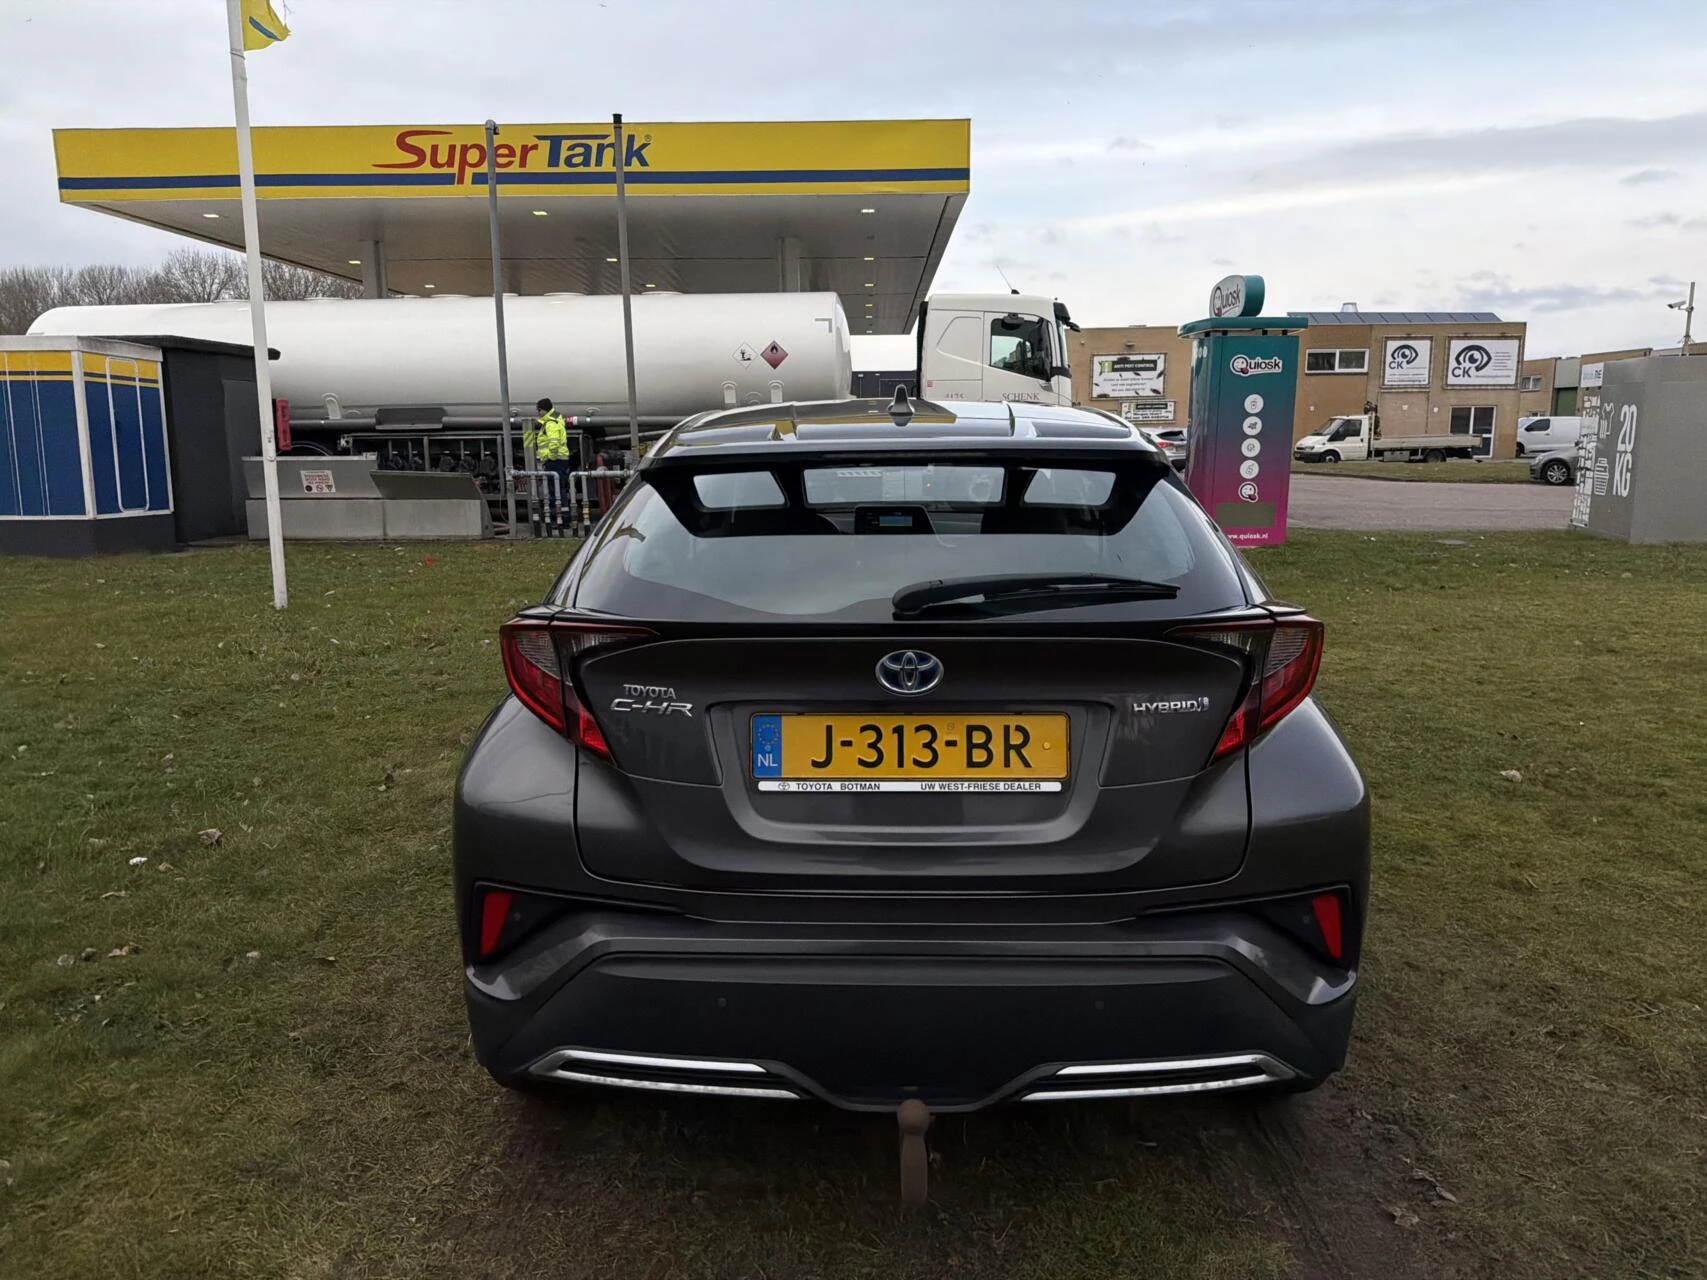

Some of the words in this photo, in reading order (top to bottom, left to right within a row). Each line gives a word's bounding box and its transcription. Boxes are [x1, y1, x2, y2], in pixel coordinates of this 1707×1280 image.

[1213, 284, 1241, 316] Quiosk
[1232, 356, 1281, 375] Quiosk
[1389, 361, 1404, 370] CK
[1451, 366, 1473, 378] CK
[1002, 392, 1040, 401] SCHENK
[1617, 404, 1637, 453] 20
[1613, 453, 1632, 497] KG
[623, 684, 677, 699] TOYOTA
[610, 698, 693, 717] C-HR
[1133, 700, 1198, 713] HYBRID
[811, 724, 1033, 769] J-313-BR
[757, 753, 778, 767] NL
[796, 782, 833, 791] TOYOTA
[840, 782, 881, 791] BOTMAN
[920, 782, 936, 791] UW
[938, 782, 1000, 791] WEST-FRIESE
[1003, 782, 1041, 791] DEALER
